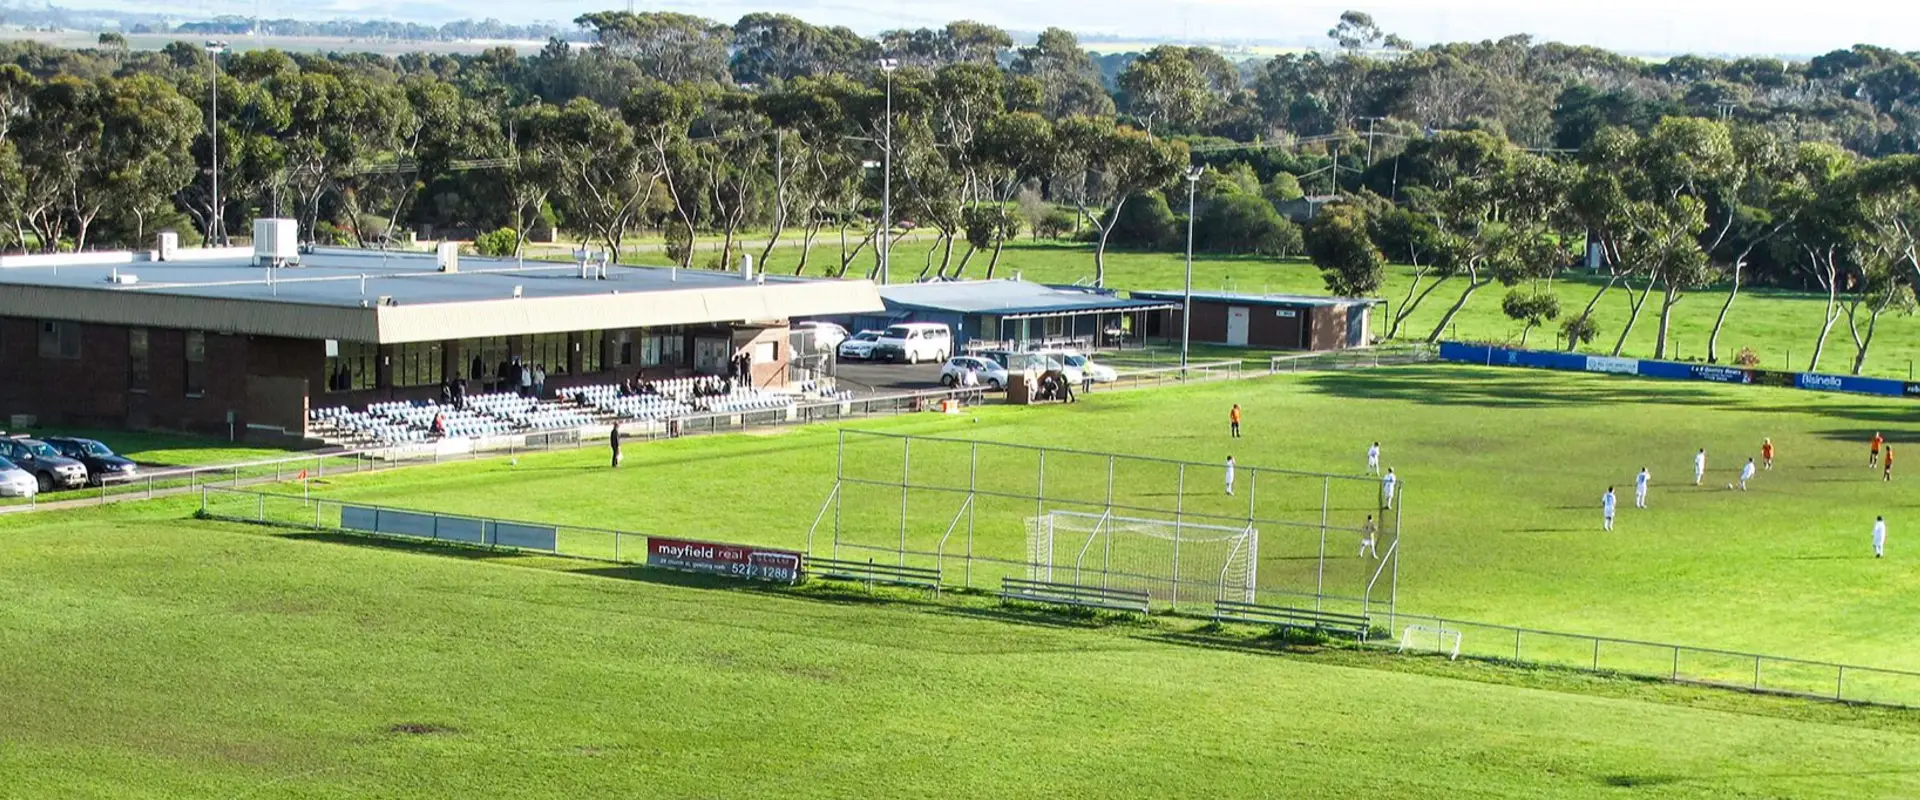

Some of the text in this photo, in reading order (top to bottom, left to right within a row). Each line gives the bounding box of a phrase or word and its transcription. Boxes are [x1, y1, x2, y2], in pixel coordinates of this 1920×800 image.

[1801, 373, 1842, 386] Bisinella
[658, 544, 789, 565] mayfield real state
[762, 566, 788, 579] 1288
